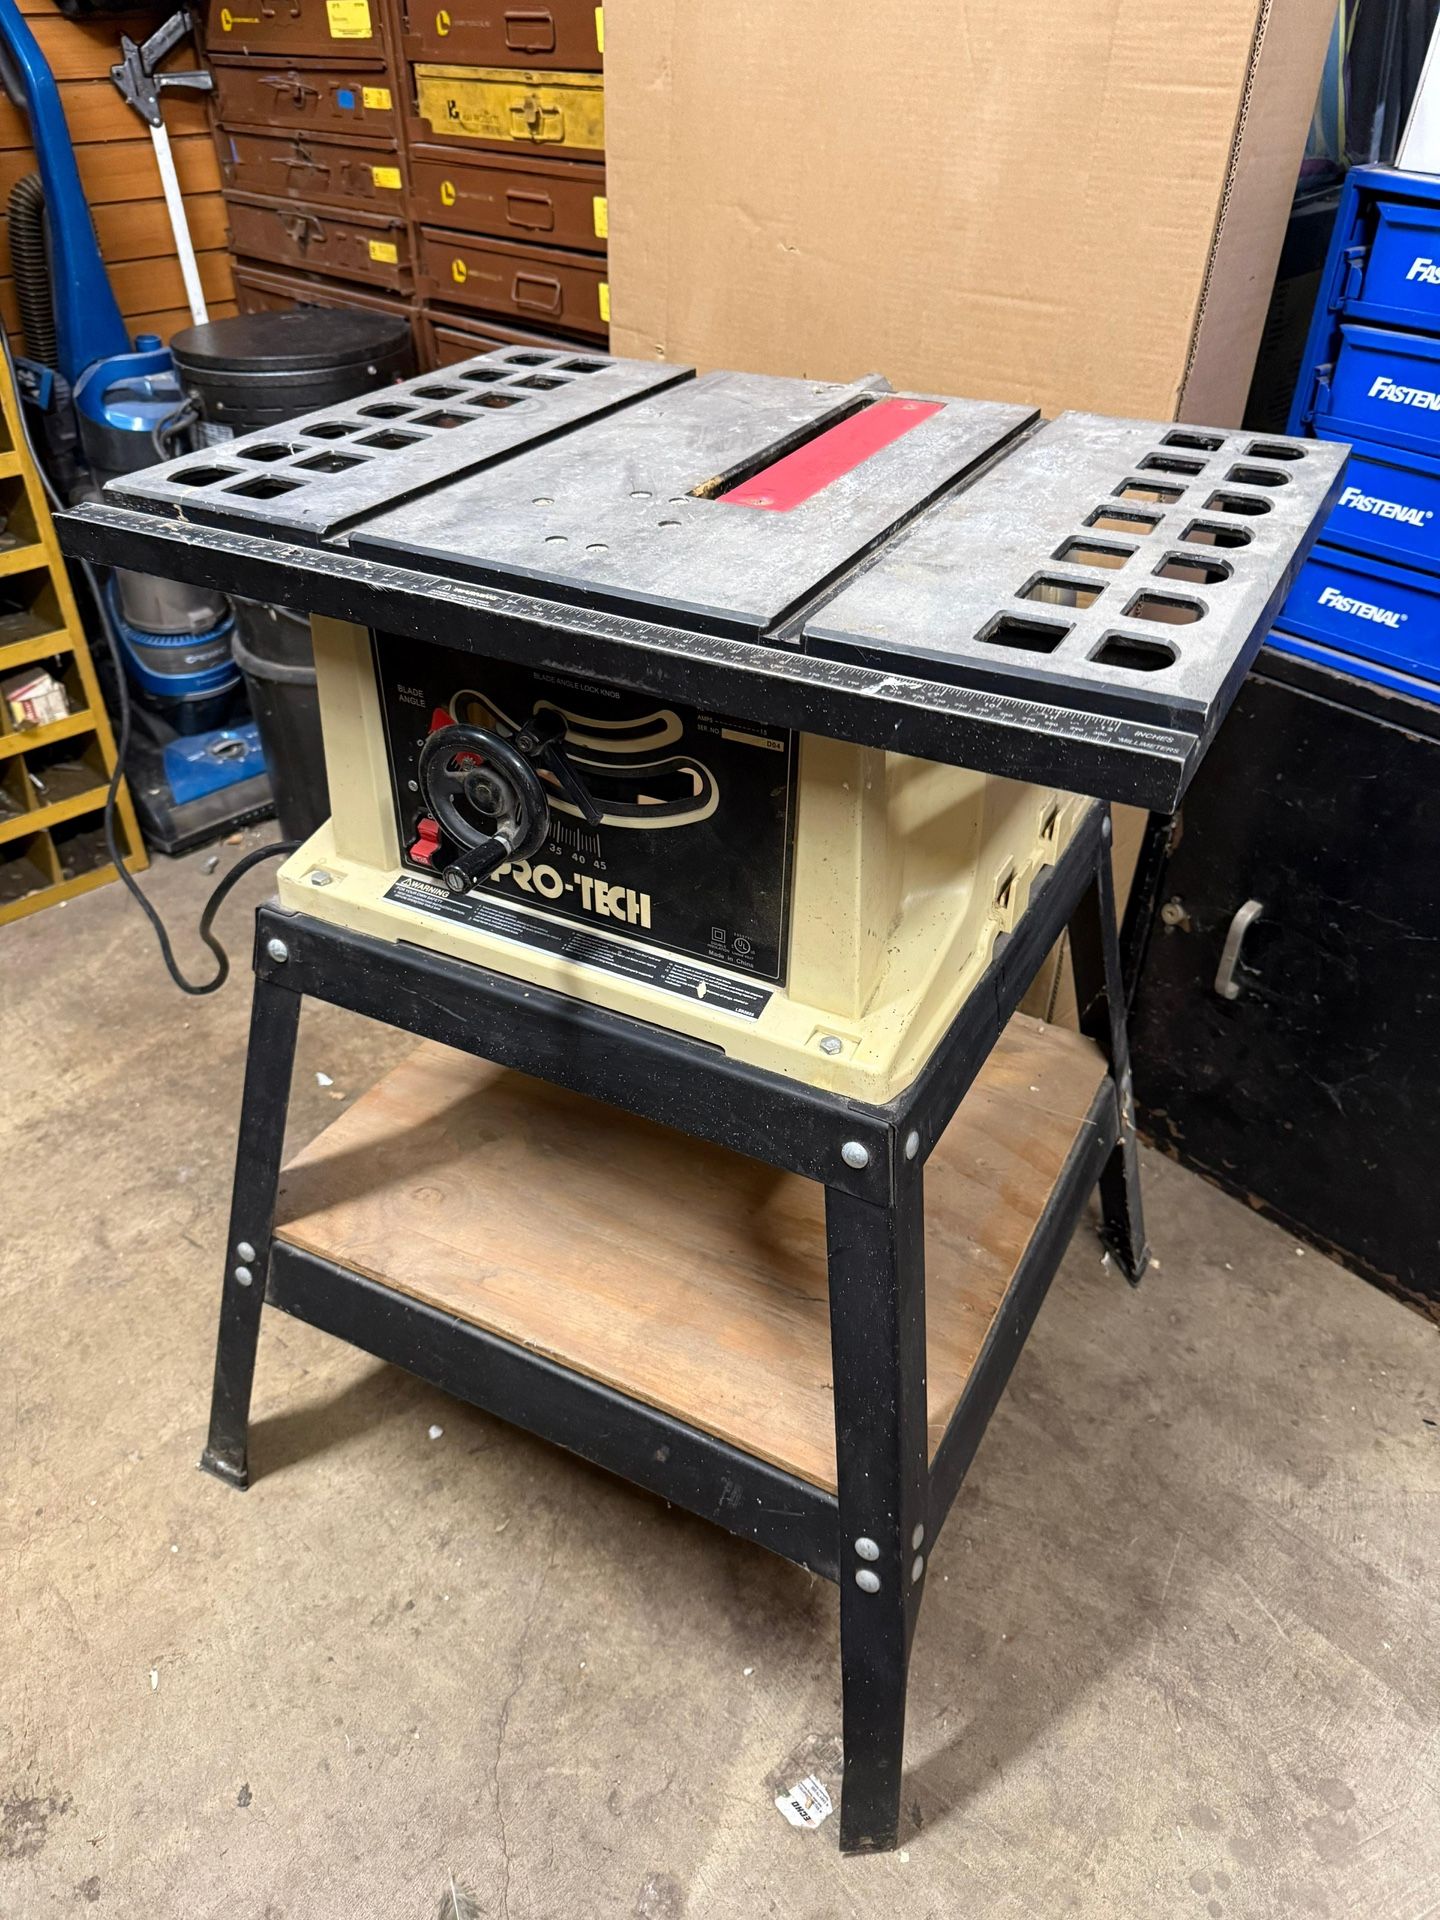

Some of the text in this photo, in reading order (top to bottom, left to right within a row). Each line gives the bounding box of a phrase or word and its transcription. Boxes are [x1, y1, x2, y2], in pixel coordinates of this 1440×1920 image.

[397, 684, 425, 699] BLADE
[556, 678, 580, 690] ANGLE
[580, 684, 600, 694] LOCK
[600, 688, 621, 699] KNOB
[399, 694, 427, 708] ANGLE
[1134, 730, 1175, 743] INCHES
[549, 843, 607, 871] 35 40 45
[411, 880, 450, 898] WARNING
[708, 949, 725, 960] Made
[736, 957, 754, 969] China
[791, 1801, 811, 1821] ECHO
